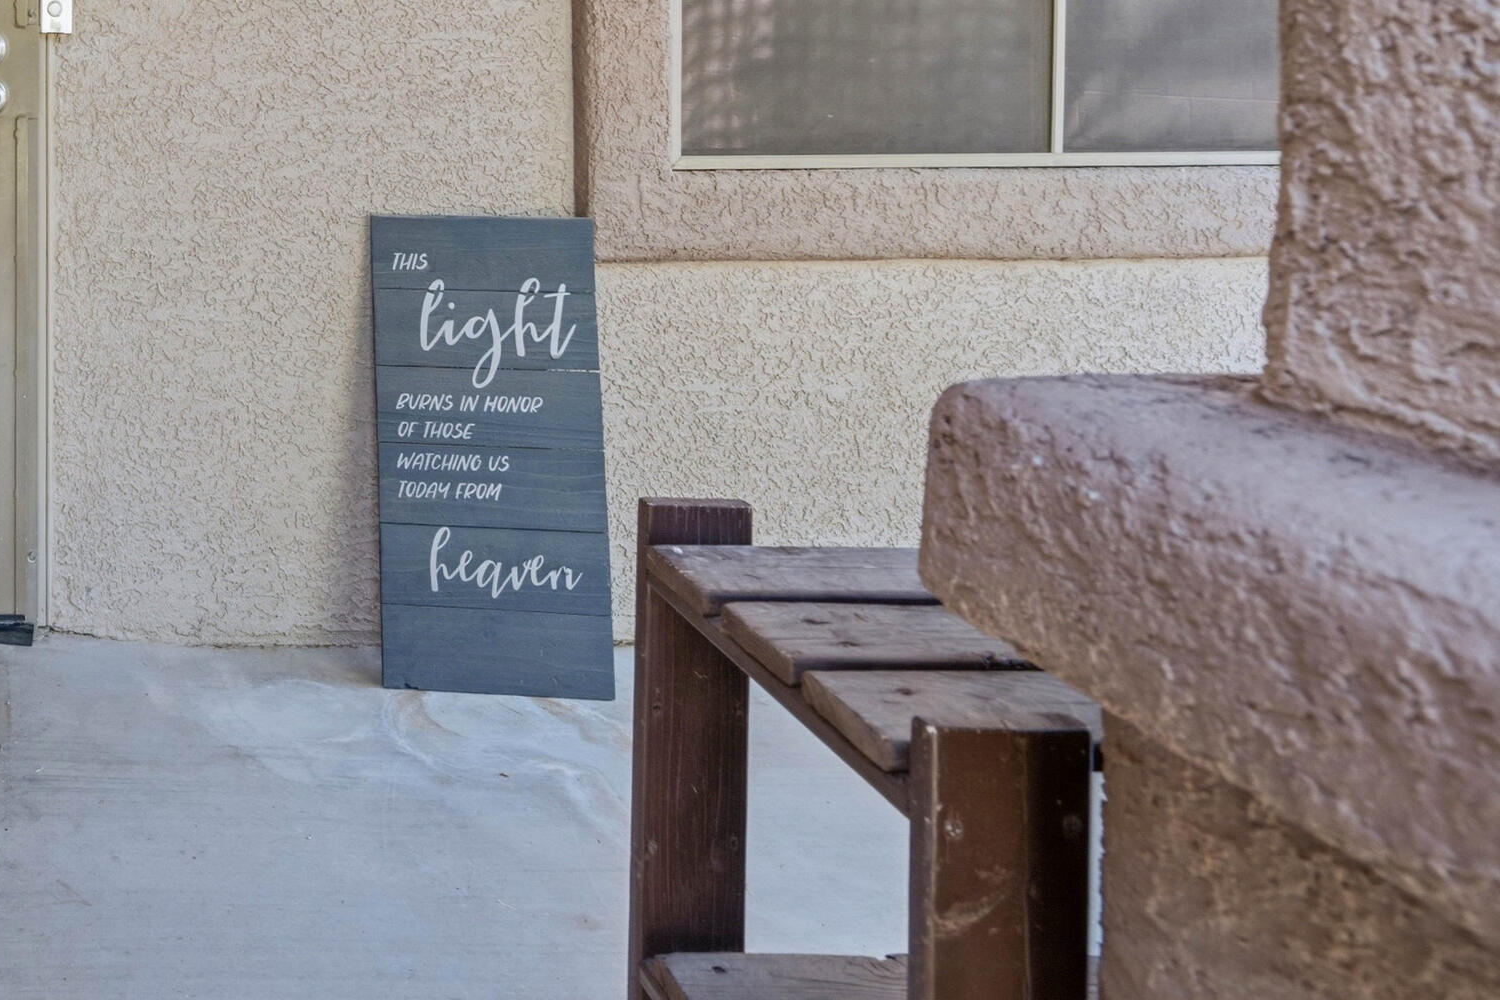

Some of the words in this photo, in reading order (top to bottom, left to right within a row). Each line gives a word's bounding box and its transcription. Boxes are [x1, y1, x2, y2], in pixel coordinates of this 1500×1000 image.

[392, 252, 429, 271] THIS
[419, 277, 577, 389] light
[395, 392, 454, 411] BURNS
[459, 394, 480, 412] IN
[484, 395, 544, 414] HONOR
[398, 420, 419, 438] OF
[423, 420, 476, 440] THOSE
[396, 451, 483, 472] WATCHING
[489, 455, 510, 473] US
[398, 480, 451, 500] TODAY
[455, 482, 503, 502] FROM
[429, 526, 584, 600] heaven
